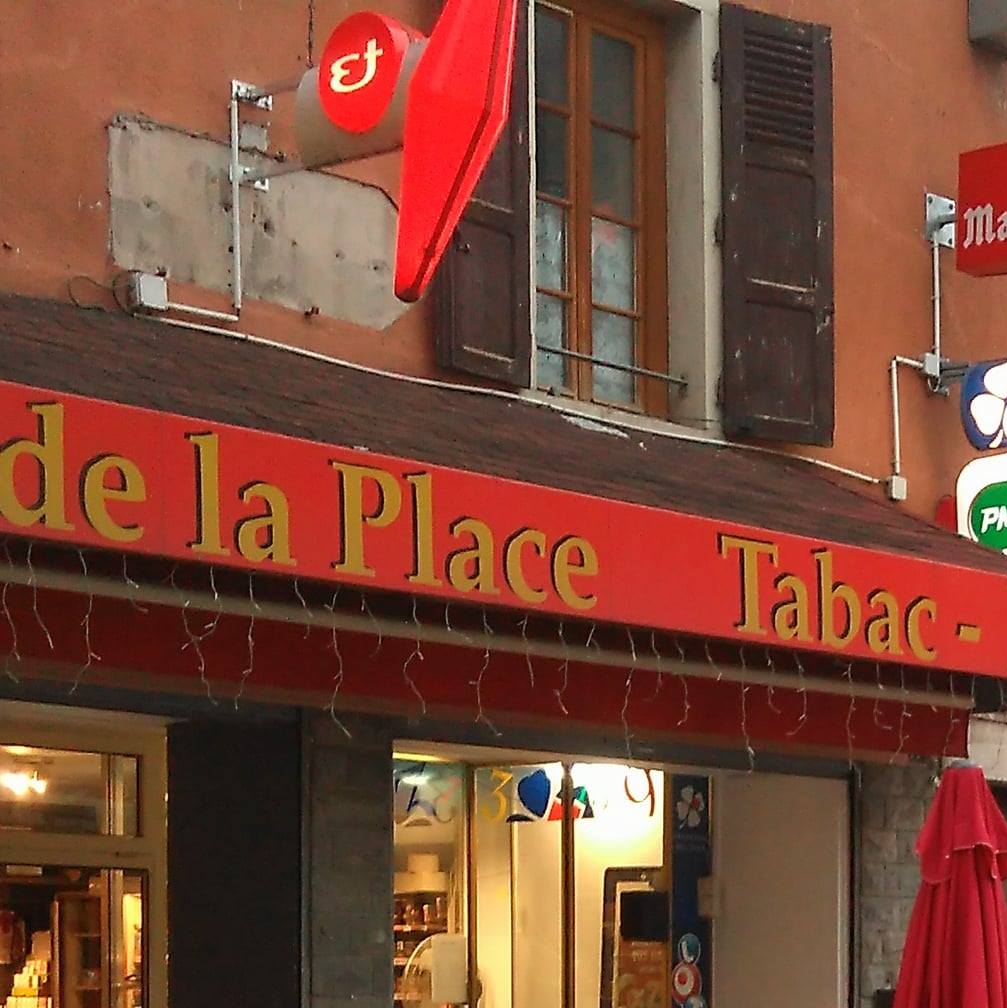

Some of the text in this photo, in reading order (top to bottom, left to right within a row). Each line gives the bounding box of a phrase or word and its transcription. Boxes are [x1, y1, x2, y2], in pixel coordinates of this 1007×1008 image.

[0, 401, 600, 610] de la Place
[716, 532, 938, 661] Tabac
